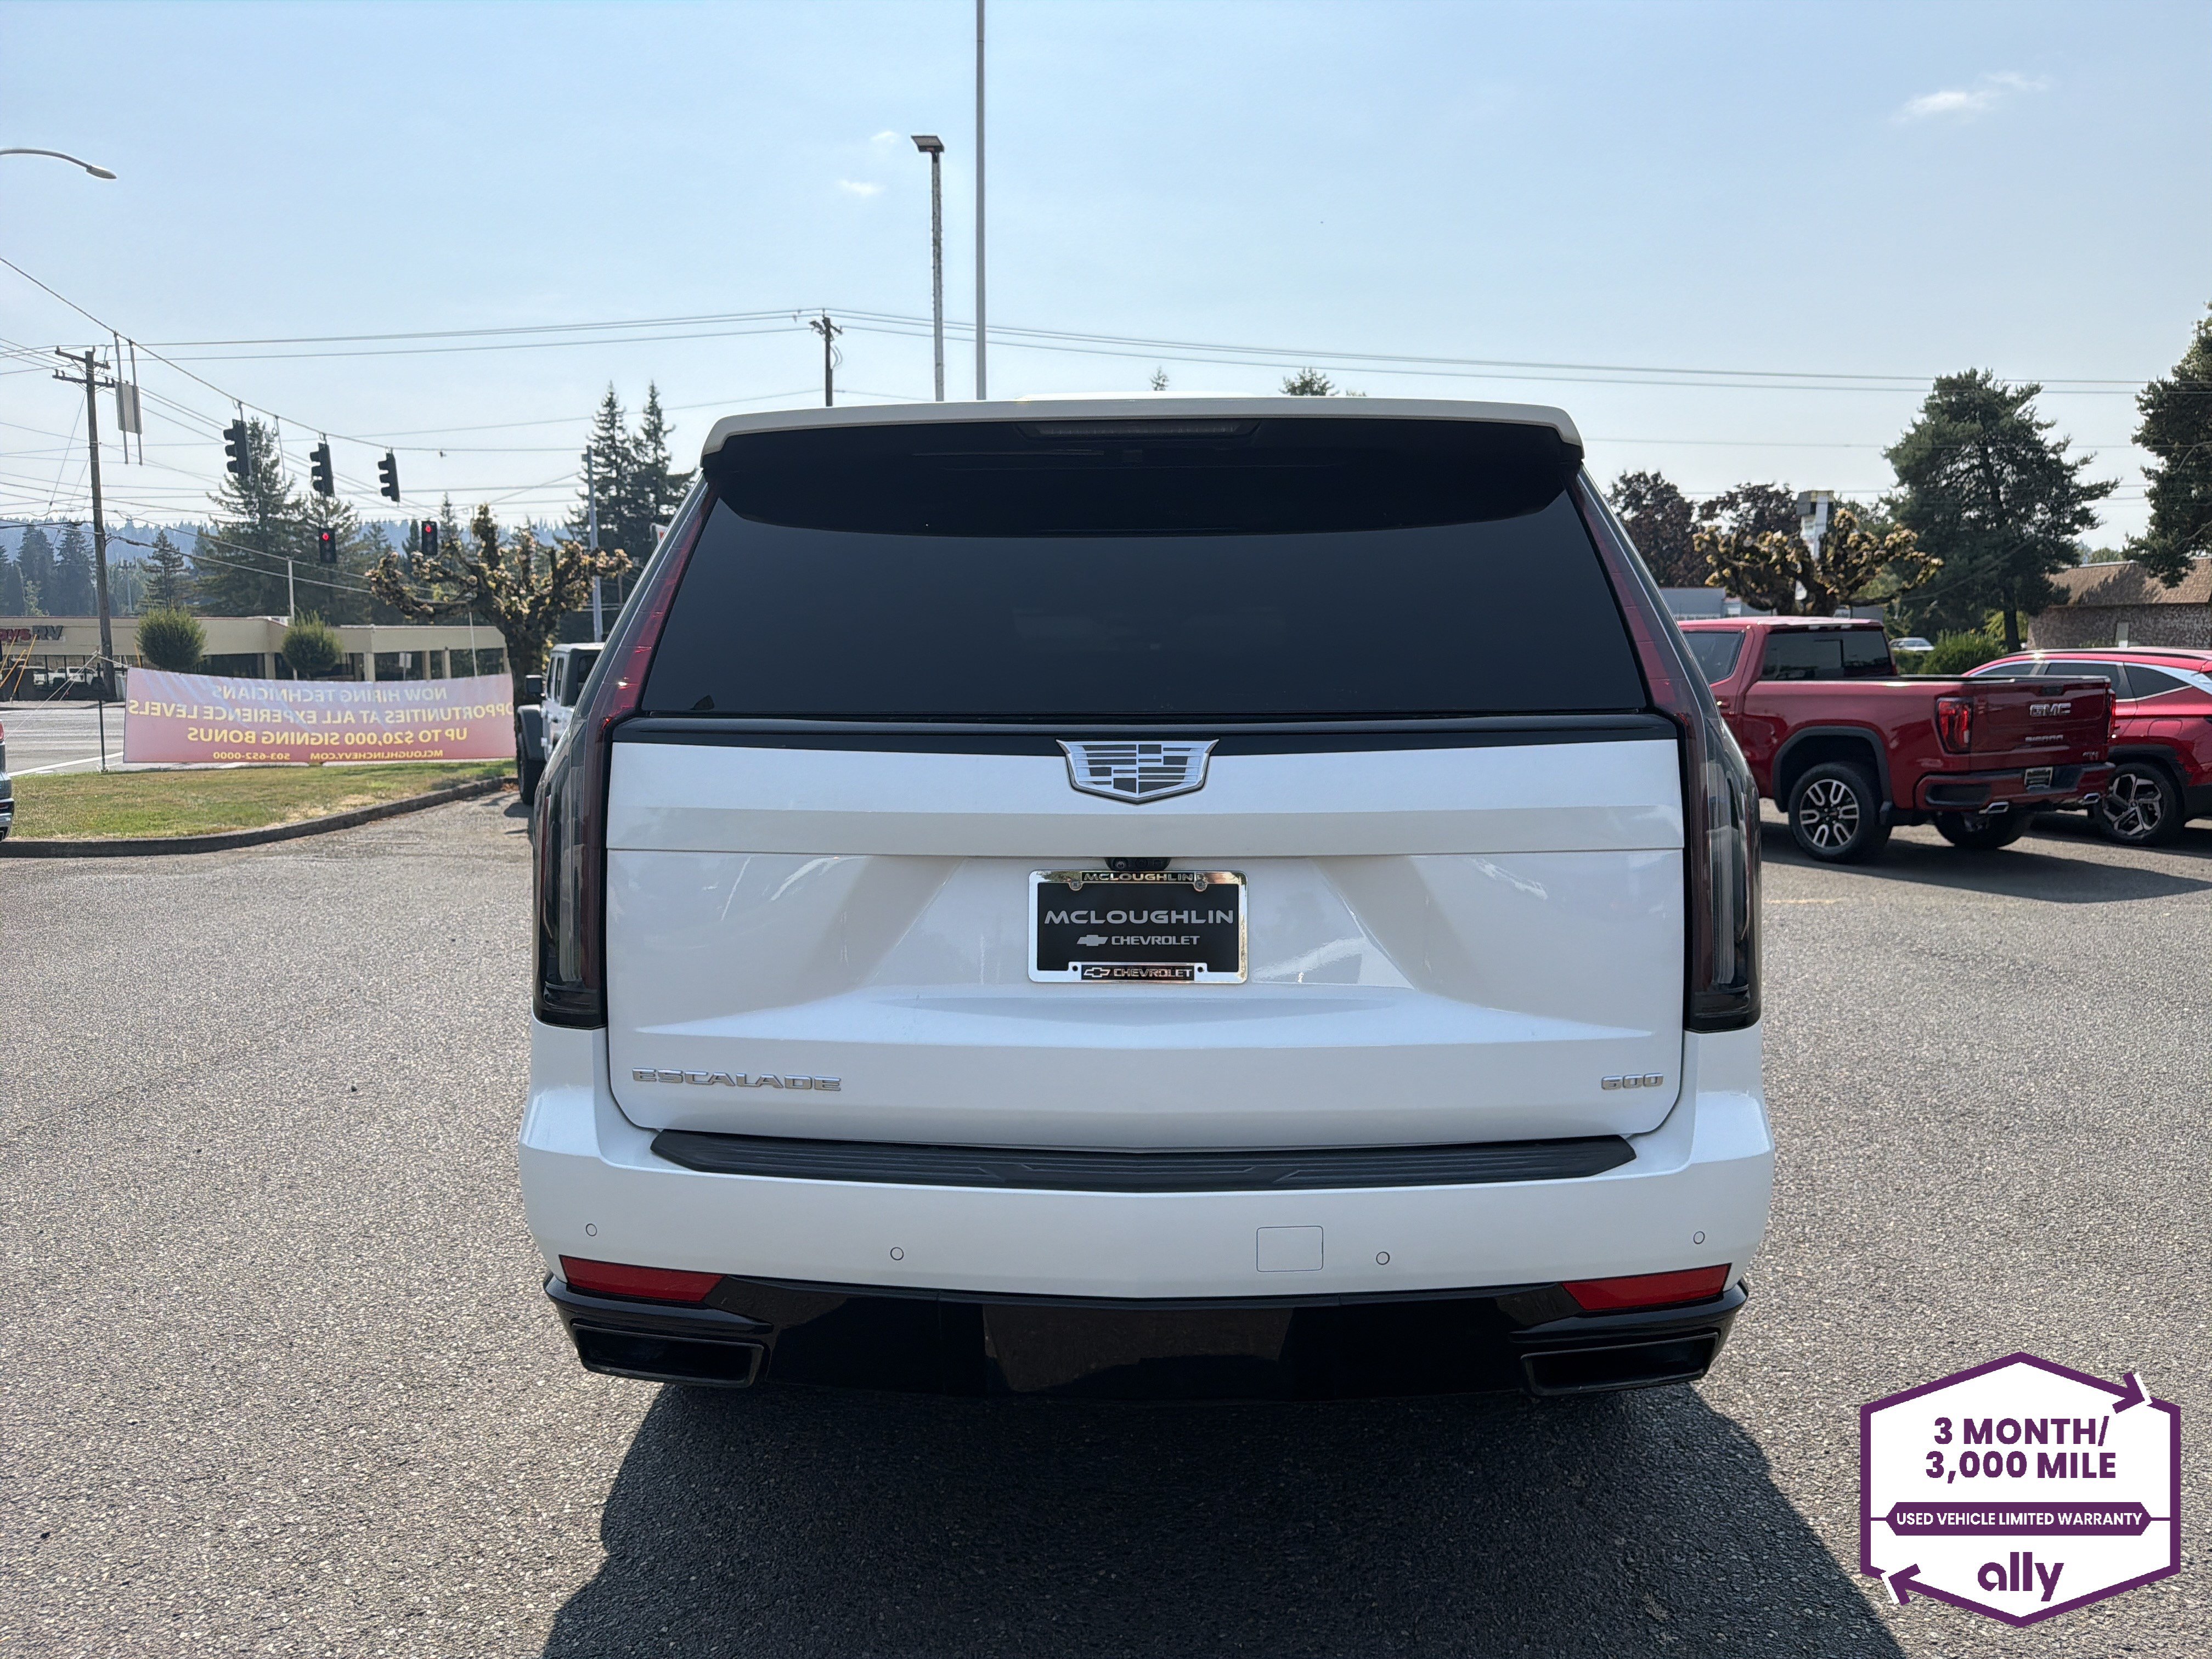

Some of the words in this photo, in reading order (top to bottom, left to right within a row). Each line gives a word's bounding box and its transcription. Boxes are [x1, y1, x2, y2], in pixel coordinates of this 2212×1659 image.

[32, 625, 64, 640] RV
[2029, 702, 2072, 716] GMC
[1084, 873, 1193, 882] MCLOUGHLIN
[1044, 910, 1234, 924] MCLOUGHLIN
[1111, 935, 1200, 945] CHEVROLET
[1113, 968, 1193, 978] CHEVROLET
[631, 1067, 842, 1092] ESCALADE
[1601, 1072, 1664, 1091] 600
